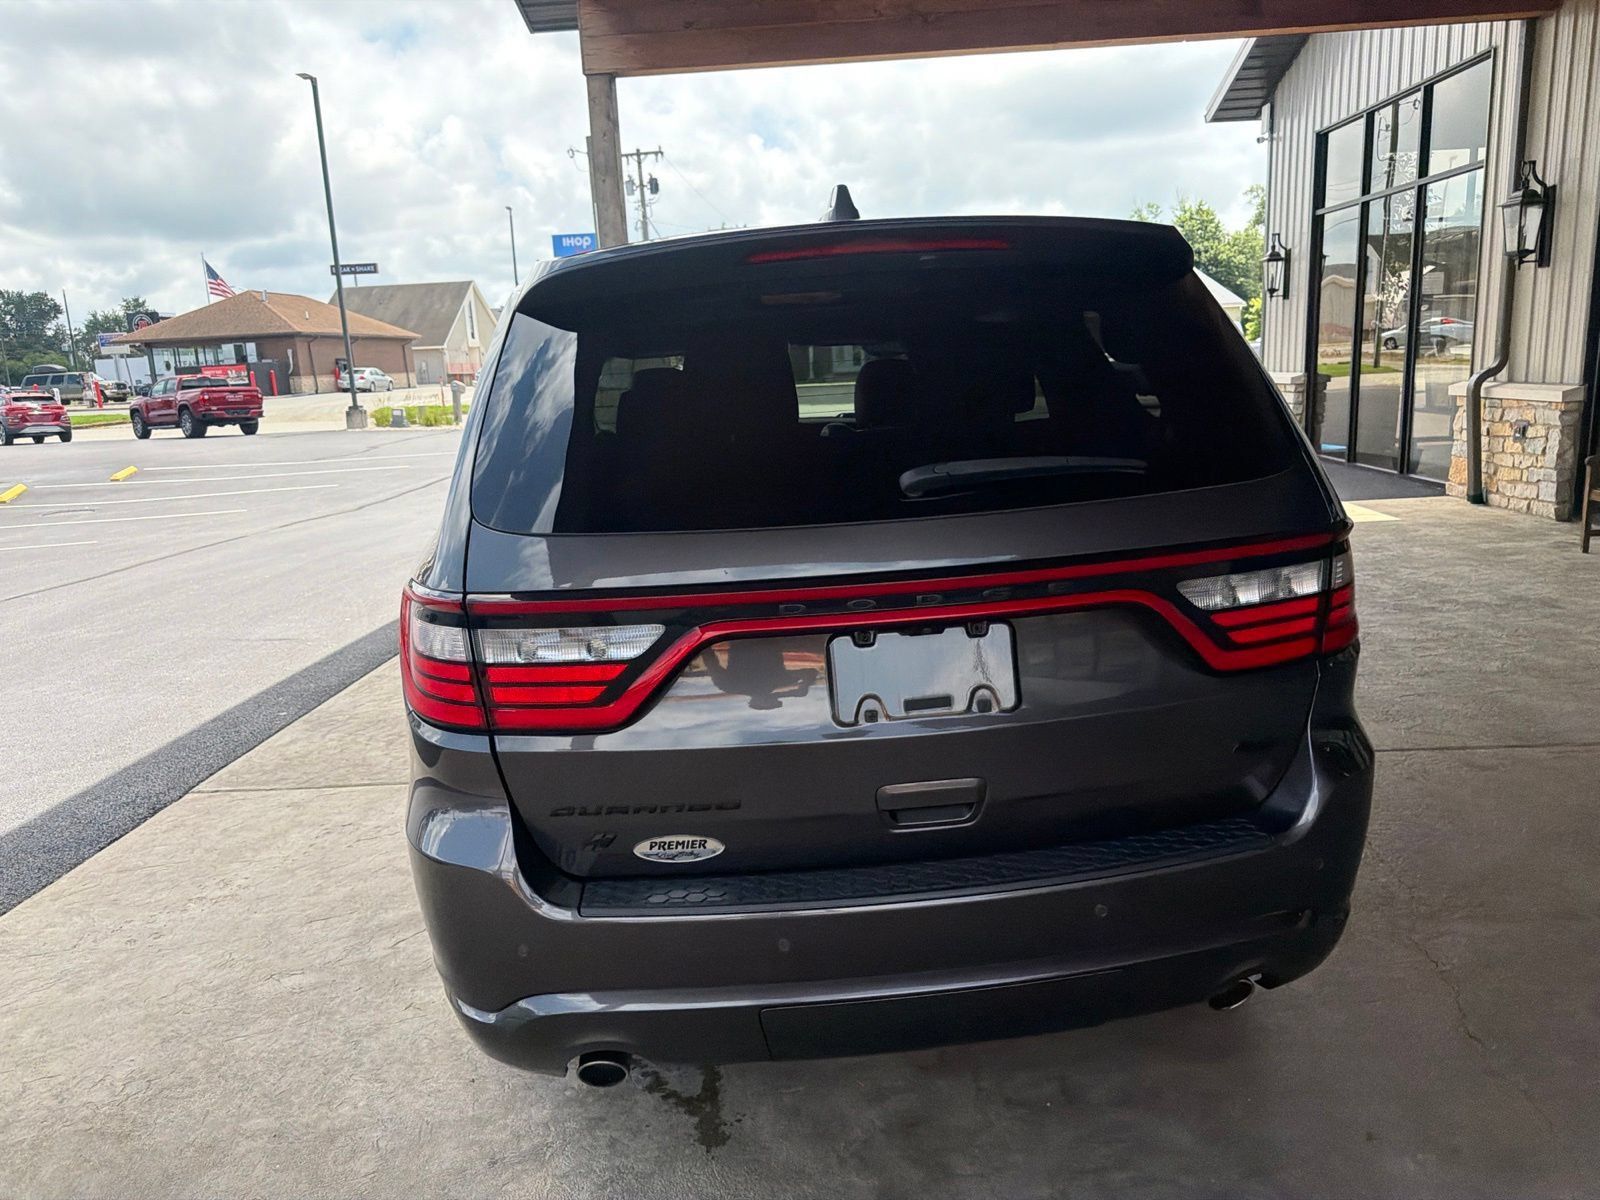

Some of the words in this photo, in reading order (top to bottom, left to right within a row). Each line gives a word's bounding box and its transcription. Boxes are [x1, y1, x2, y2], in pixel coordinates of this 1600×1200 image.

[779, 583, 1071, 616] DODGE
[549, 800, 741, 817] DURANGO
[649, 839, 708, 851] PREMIER
